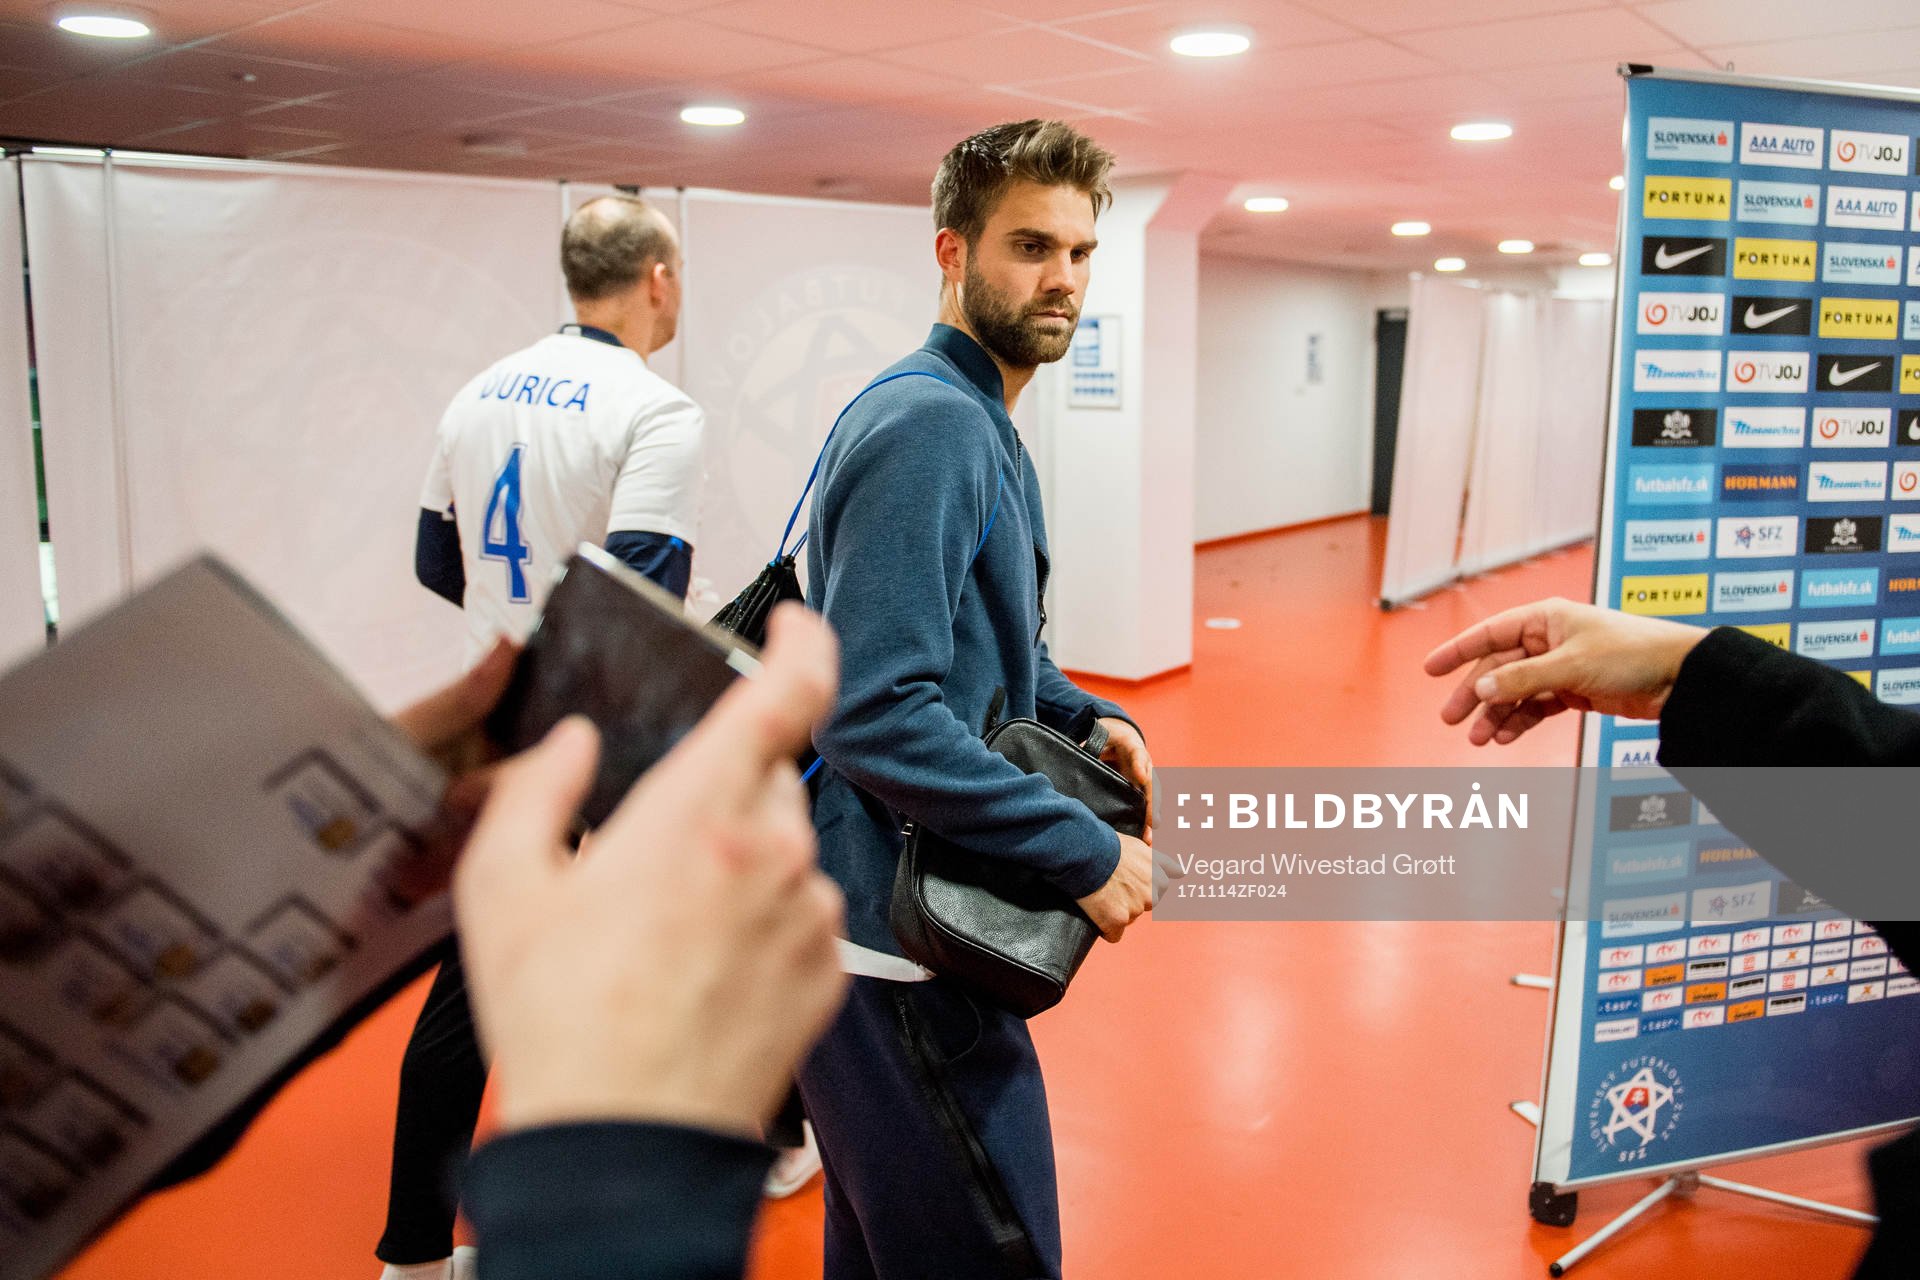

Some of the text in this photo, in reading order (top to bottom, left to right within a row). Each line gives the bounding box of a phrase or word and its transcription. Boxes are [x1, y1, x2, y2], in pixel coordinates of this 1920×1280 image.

[1750, 136, 1815, 152] AAA AUTO
[1648, 191, 1726, 205] FORTUNA
[1836, 200, 1898, 215] AAA AUTO
[1739, 252, 1811, 266] FORTUNA
[1824, 312, 1893, 325] FORTUNA
[479, 442, 534, 603] 4
[1758, 526, 1782, 540] SFZ
[1626, 589, 1703, 602] FORTUNA
[1622, 752, 1650, 764] AAA
